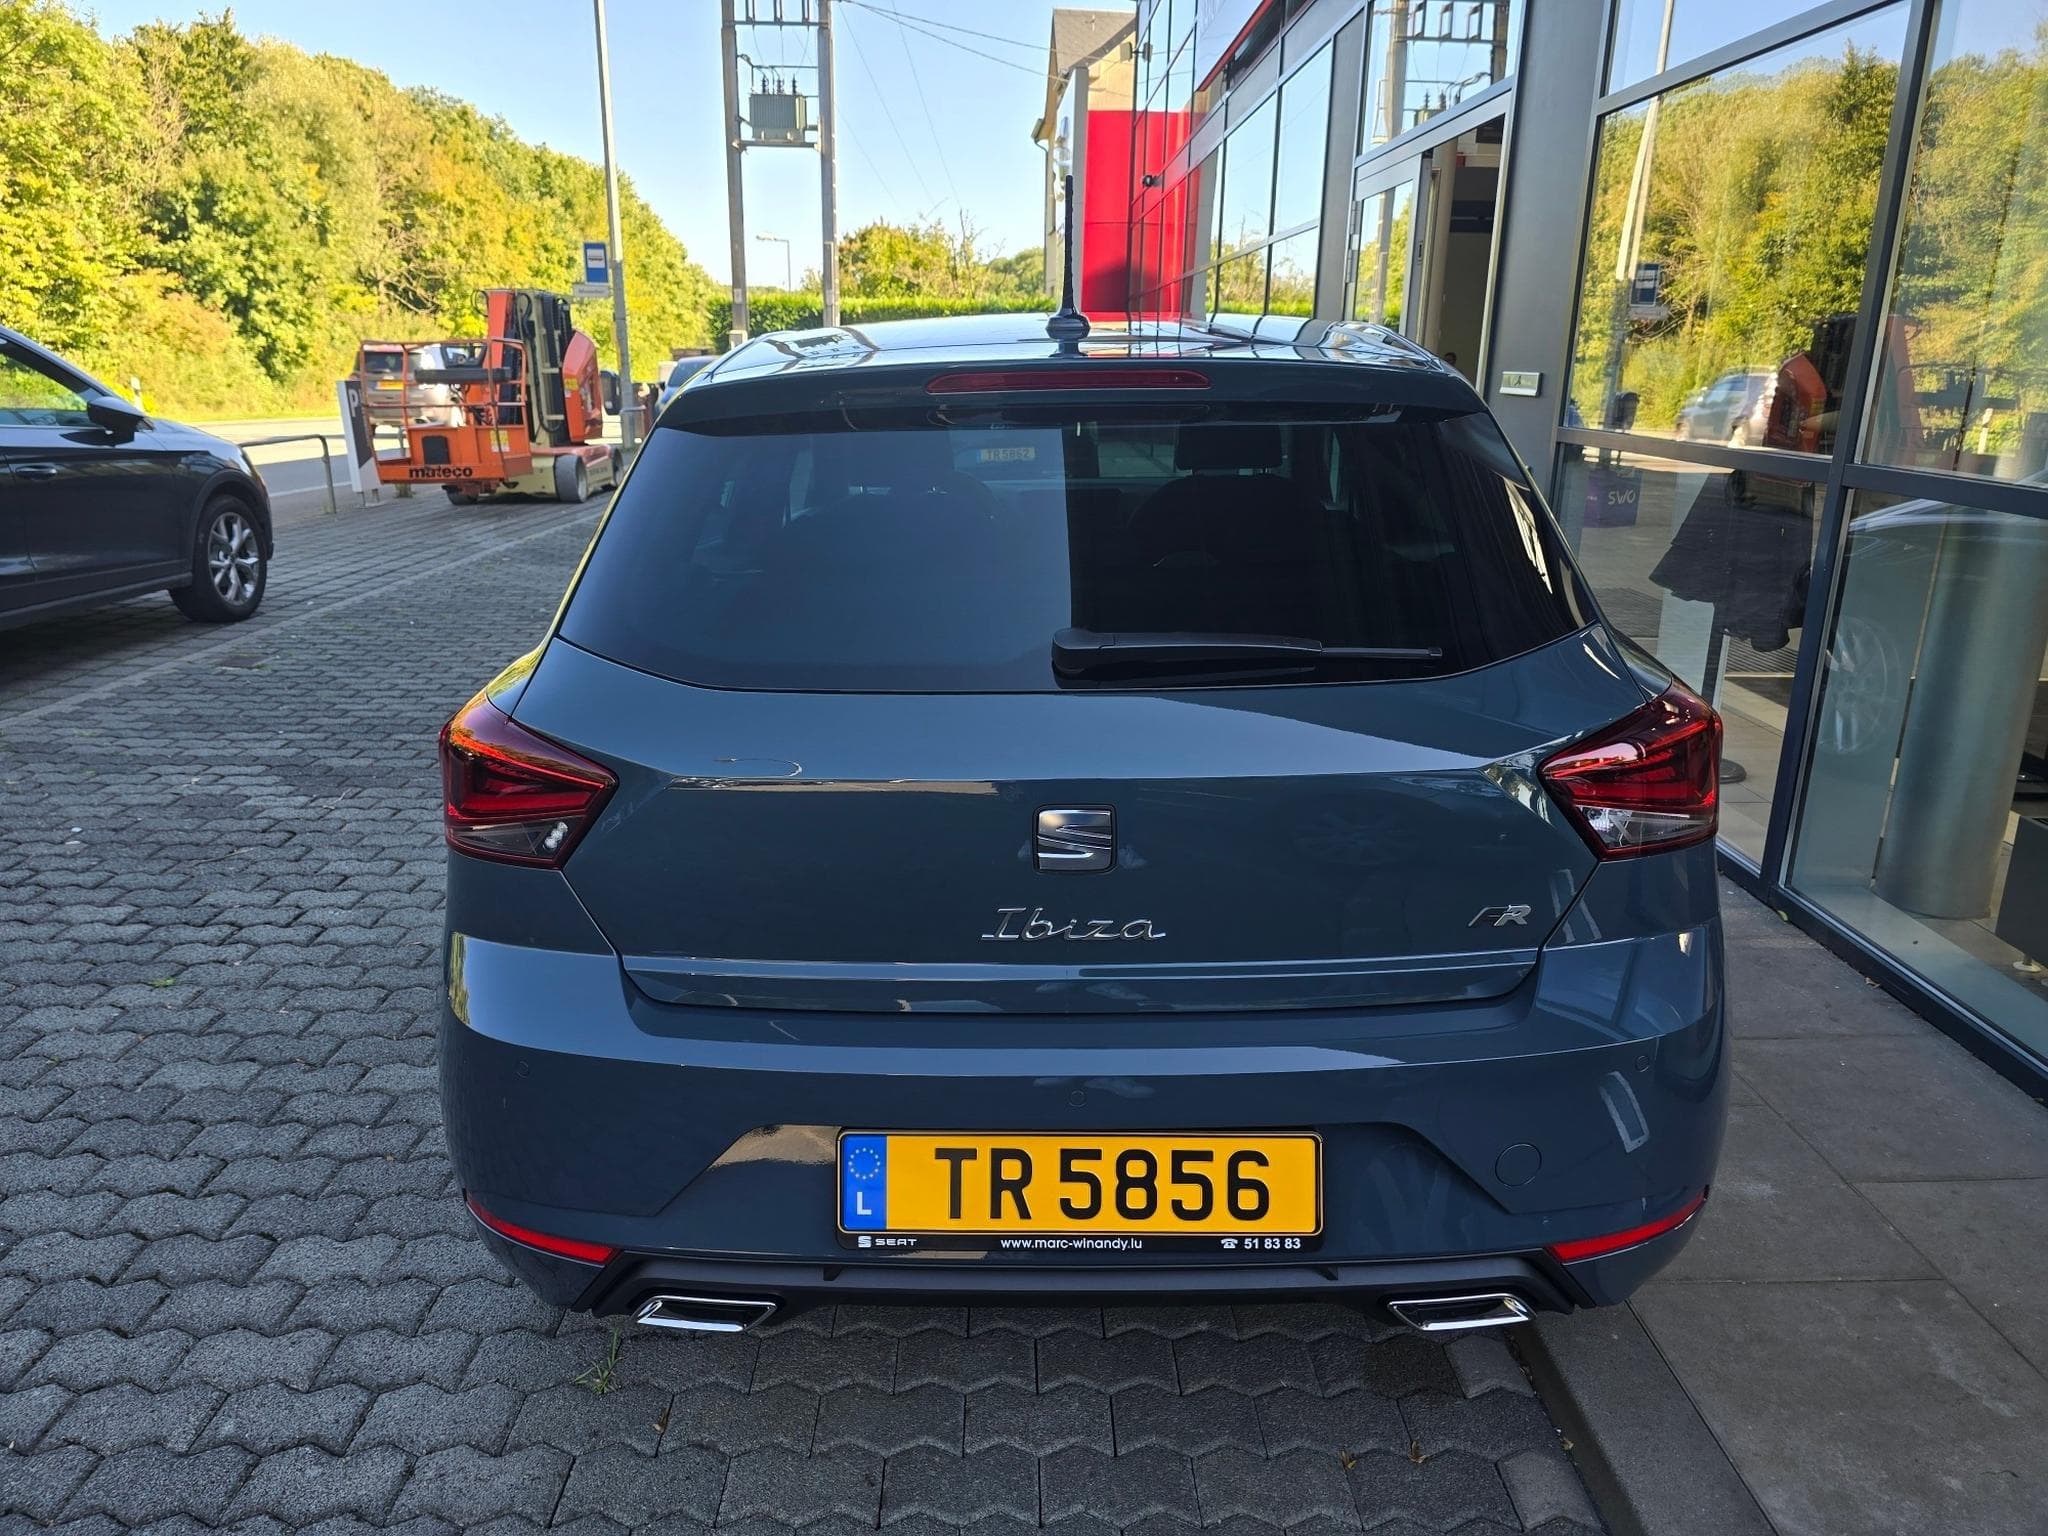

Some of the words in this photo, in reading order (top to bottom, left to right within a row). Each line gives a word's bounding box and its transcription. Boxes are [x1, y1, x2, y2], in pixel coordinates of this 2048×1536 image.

[409, 466, 473, 478] mateco
[979, 907, 1167, 942] Ibiza
[934, 1147, 1033, 1220] TR
[1059, 1148, 1270, 1221] 5856
[856, 1191, 873, 1216] L
[875, 1238, 918, 1247] SEAT
[1000, 1236, 1143, 1251] www.marc-winandy.lu
[1243, 1238, 1260, 1249] 51
[1264, 1238, 1281, 1249] 83
[1284, 1238, 1301, 1249] 83
